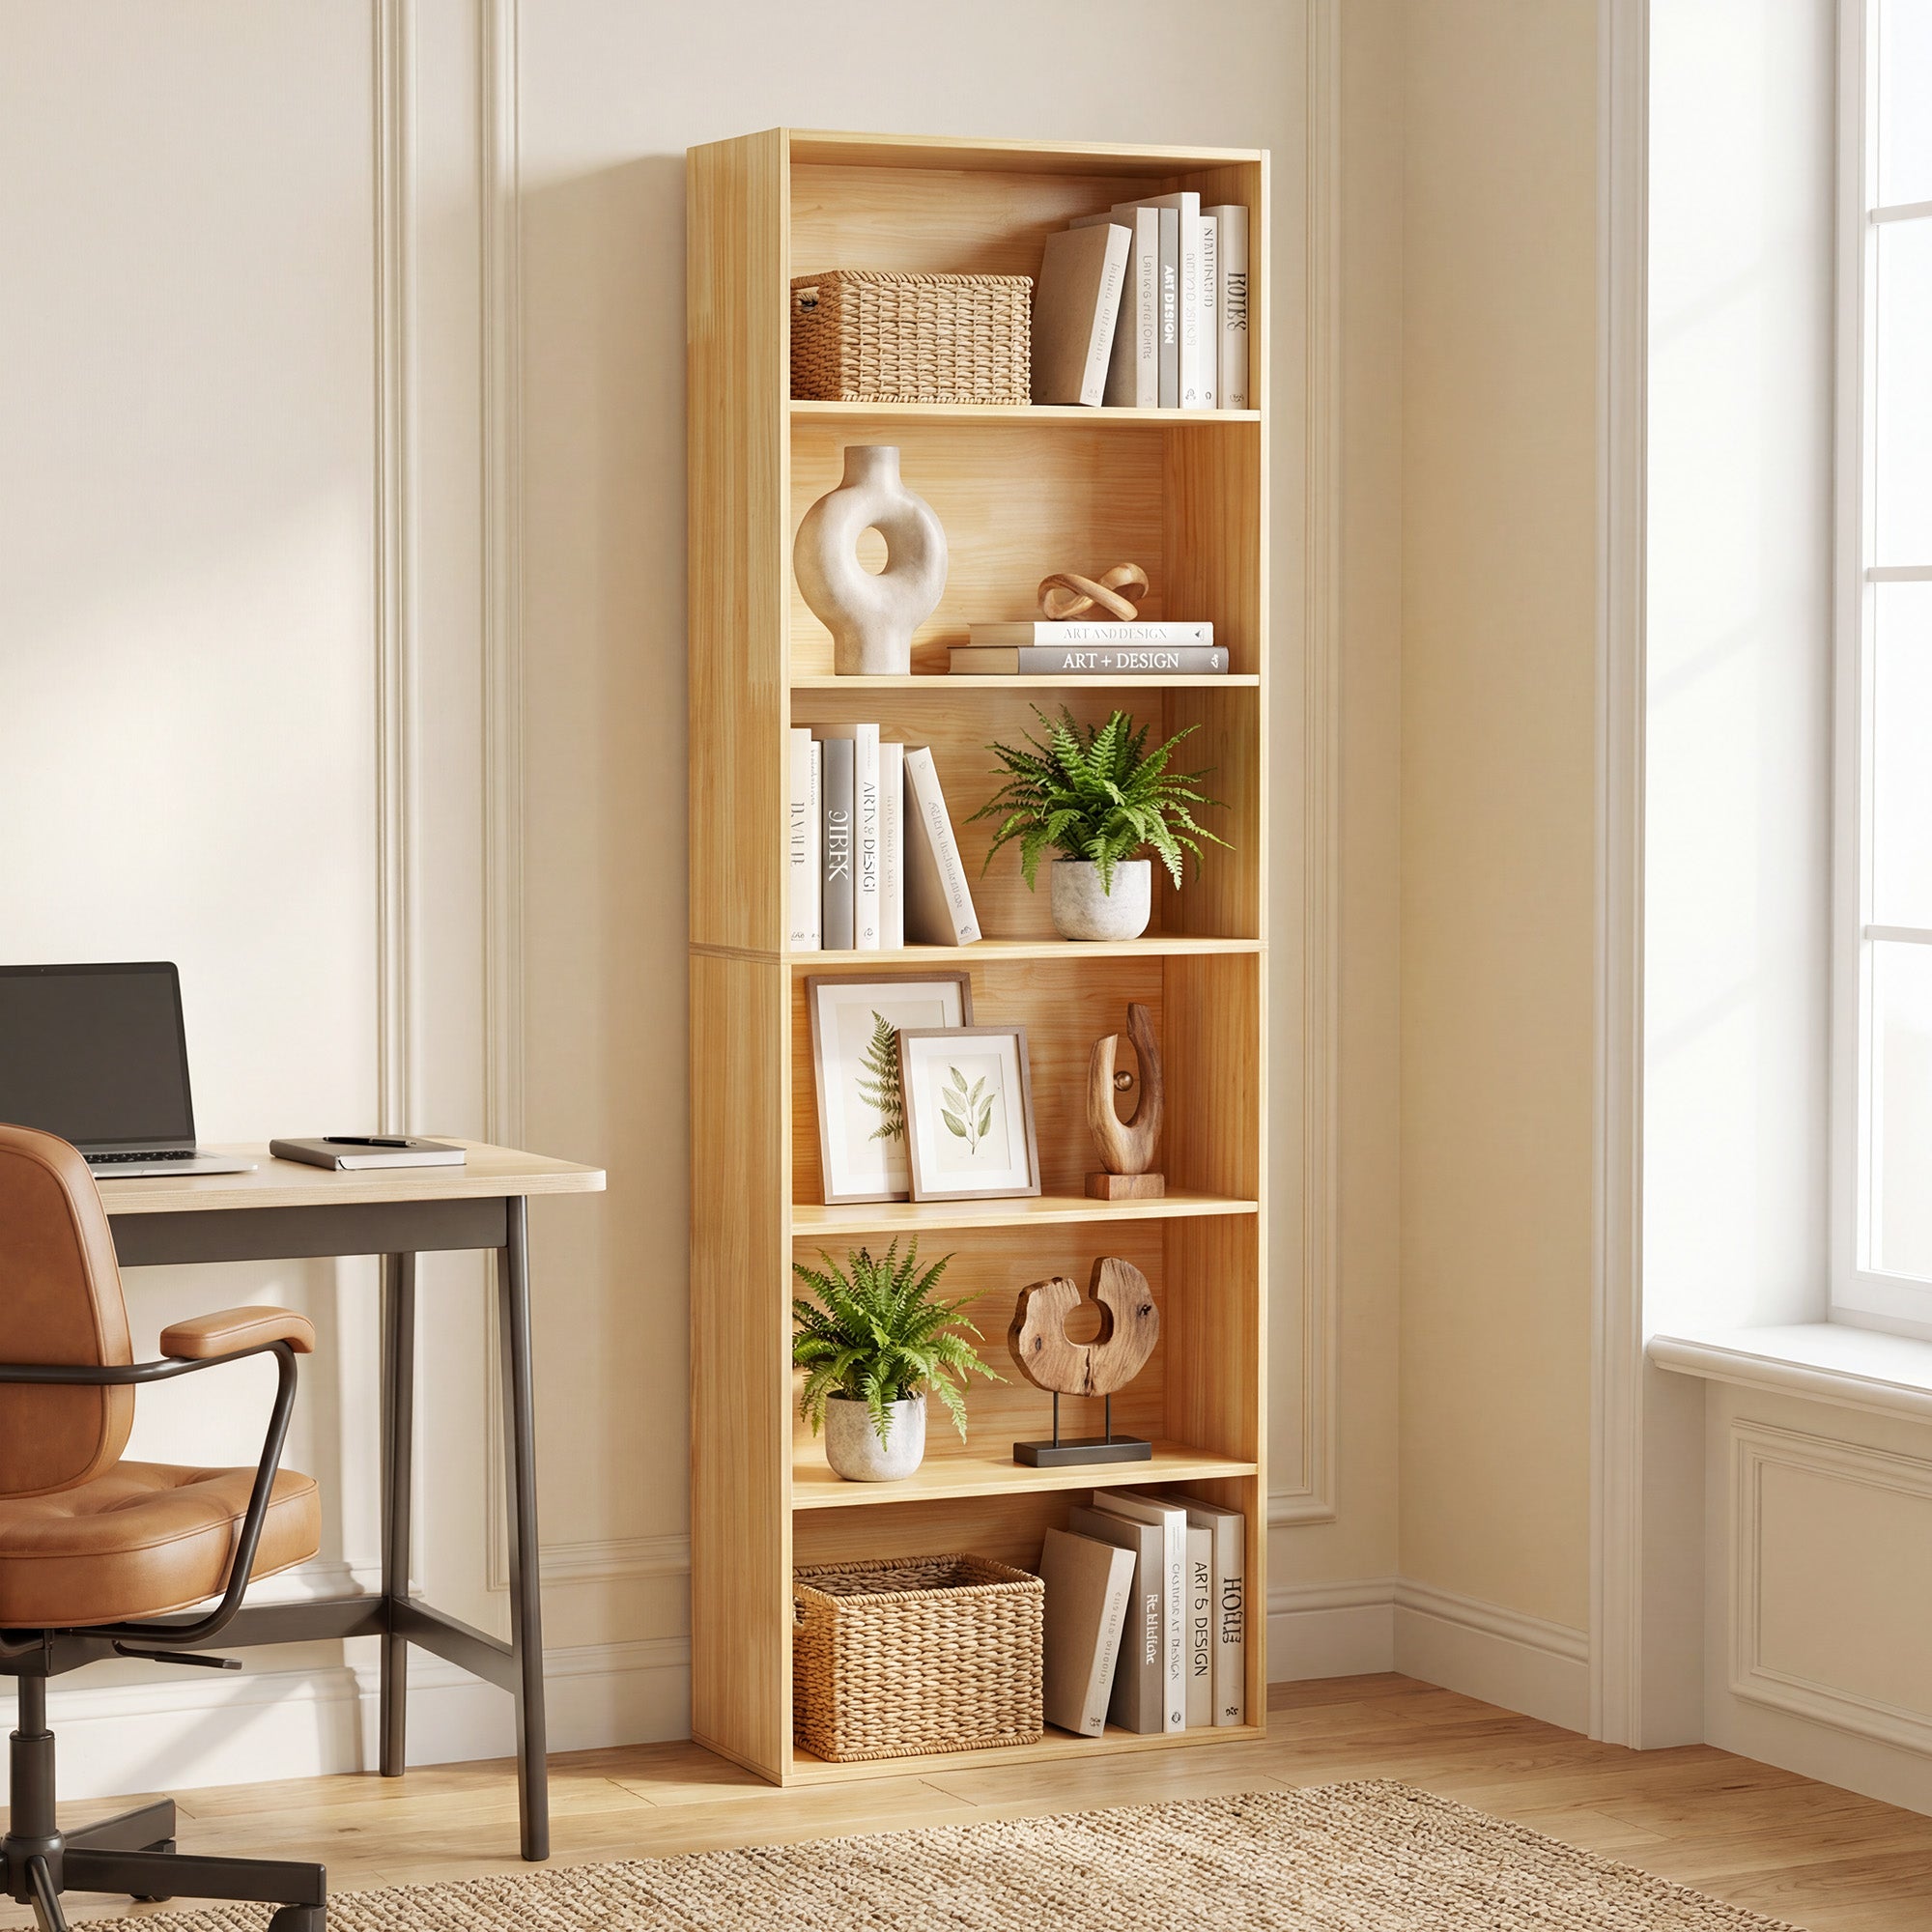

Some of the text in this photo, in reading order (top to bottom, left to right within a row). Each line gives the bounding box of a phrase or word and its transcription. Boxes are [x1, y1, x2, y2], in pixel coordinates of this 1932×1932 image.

[1164, 294, 1175, 344] DESIGN
[1064, 628, 1091, 639] ART
[1063, 653, 1179, 668] ART + DESIGN
[1194, 1561, 1208, 1594] ART
[1194, 1617, 1208, 1677] DESIGN
